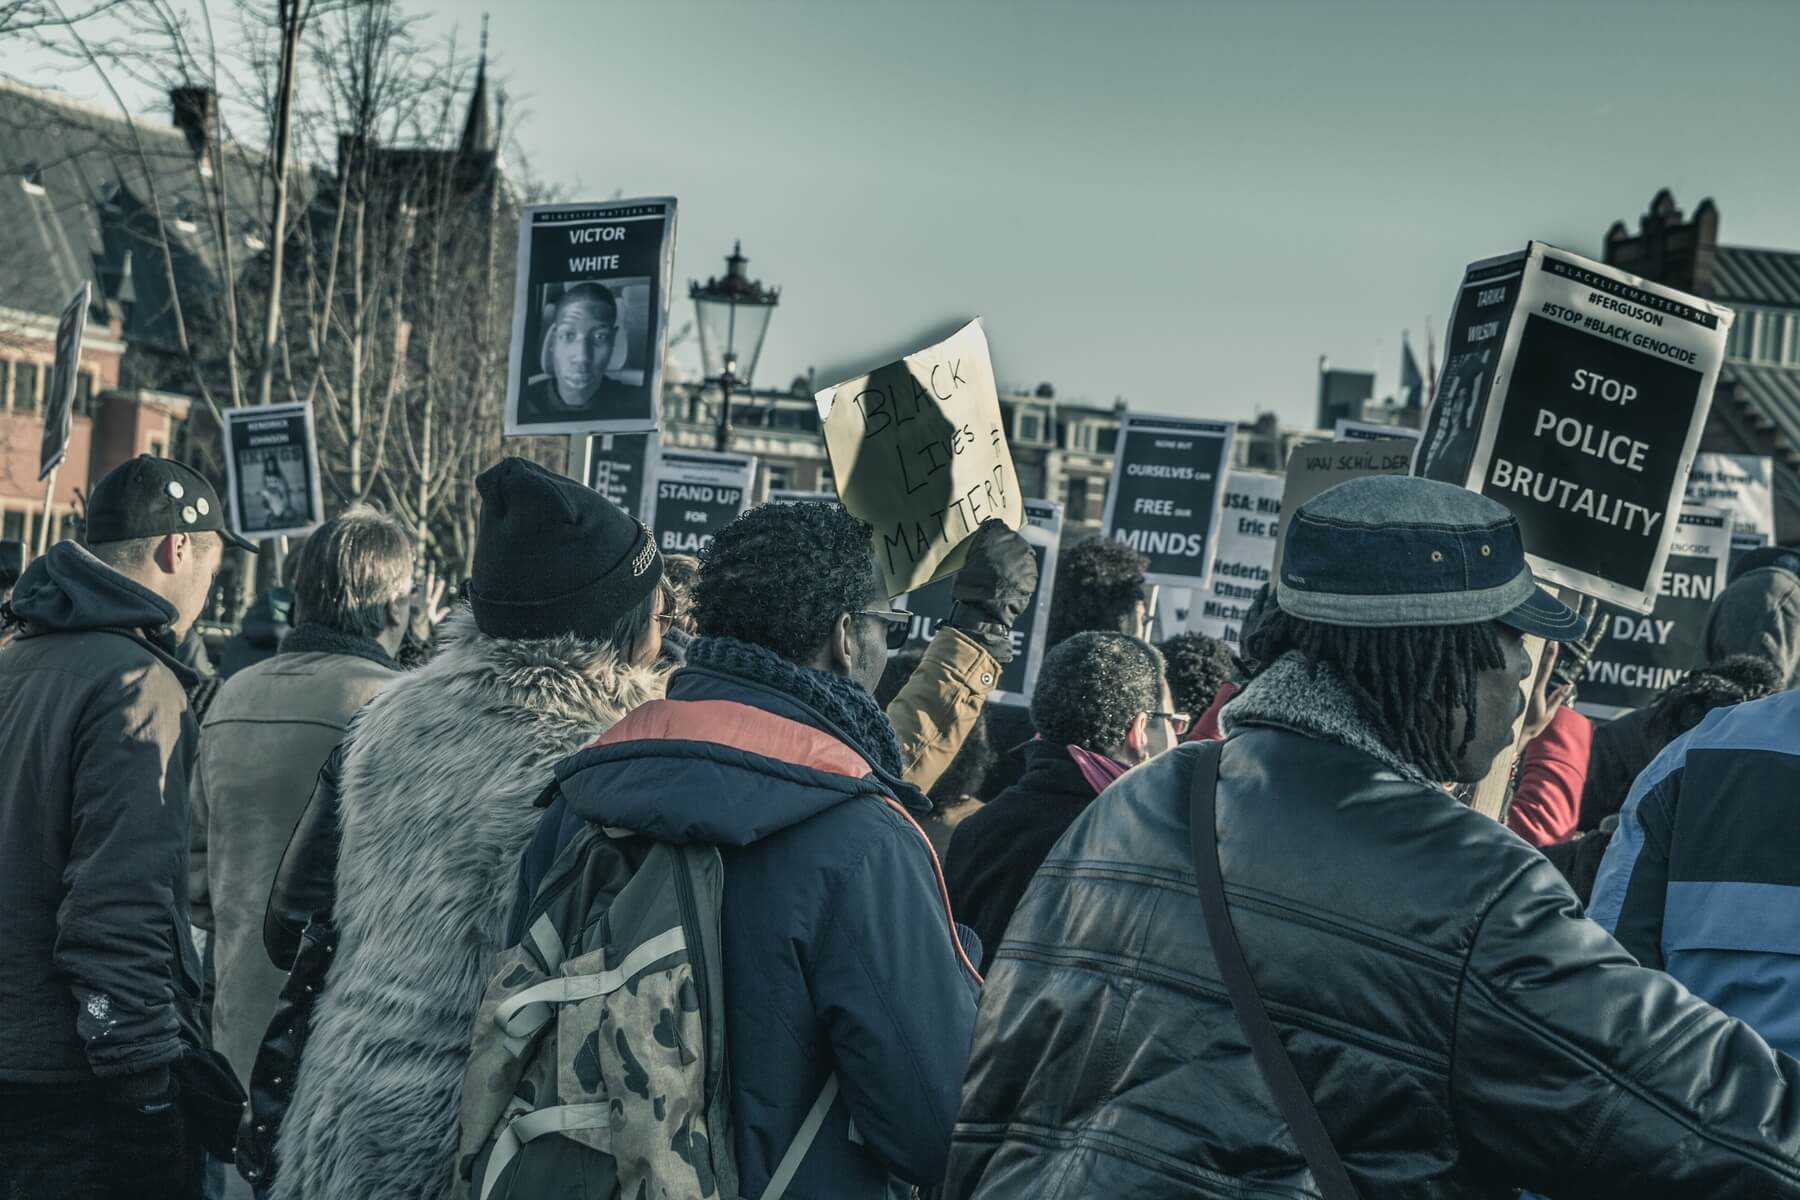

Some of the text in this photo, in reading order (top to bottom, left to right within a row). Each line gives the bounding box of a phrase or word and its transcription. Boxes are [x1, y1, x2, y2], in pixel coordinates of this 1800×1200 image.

[569, 226, 627, 245] VICTOR
[569, 254, 621, 273] WHITE
[1588, 292, 1665, 327] #FERGUSON
[1542, 301, 1697, 366] #STOP #BLACK GENOCIDE
[853, 358, 967, 440] BLACK
[1571, 368, 1638, 406] STOP
[1533, 408, 1650, 473] POLICE
[896, 423, 975, 495] LIVES
[1127, 463, 1194, 480] OURSELVES
[1306, 455, 1333, 471] VAN
[659, 484, 742, 506] STAND UP
[1134, 497, 1175, 517] FREE
[1491, 457, 1662, 537] BRUTALITY
[684, 510, 708, 524] FOR
[883, 465, 1008, 576] MATTER!
[1238, 517, 1266, 537] Eric
[661, 531, 716, 552] BLAC
[1115, 527, 1203, 558] MINDS
[1669, 542, 1711, 555] ENOCIDE
[1213, 560, 1269, 582] Nederla
[1657, 572, 1713, 600] ERN
[1612, 615, 1676, 645] DAY
[1582, 659, 1691, 690] YNCHIN
